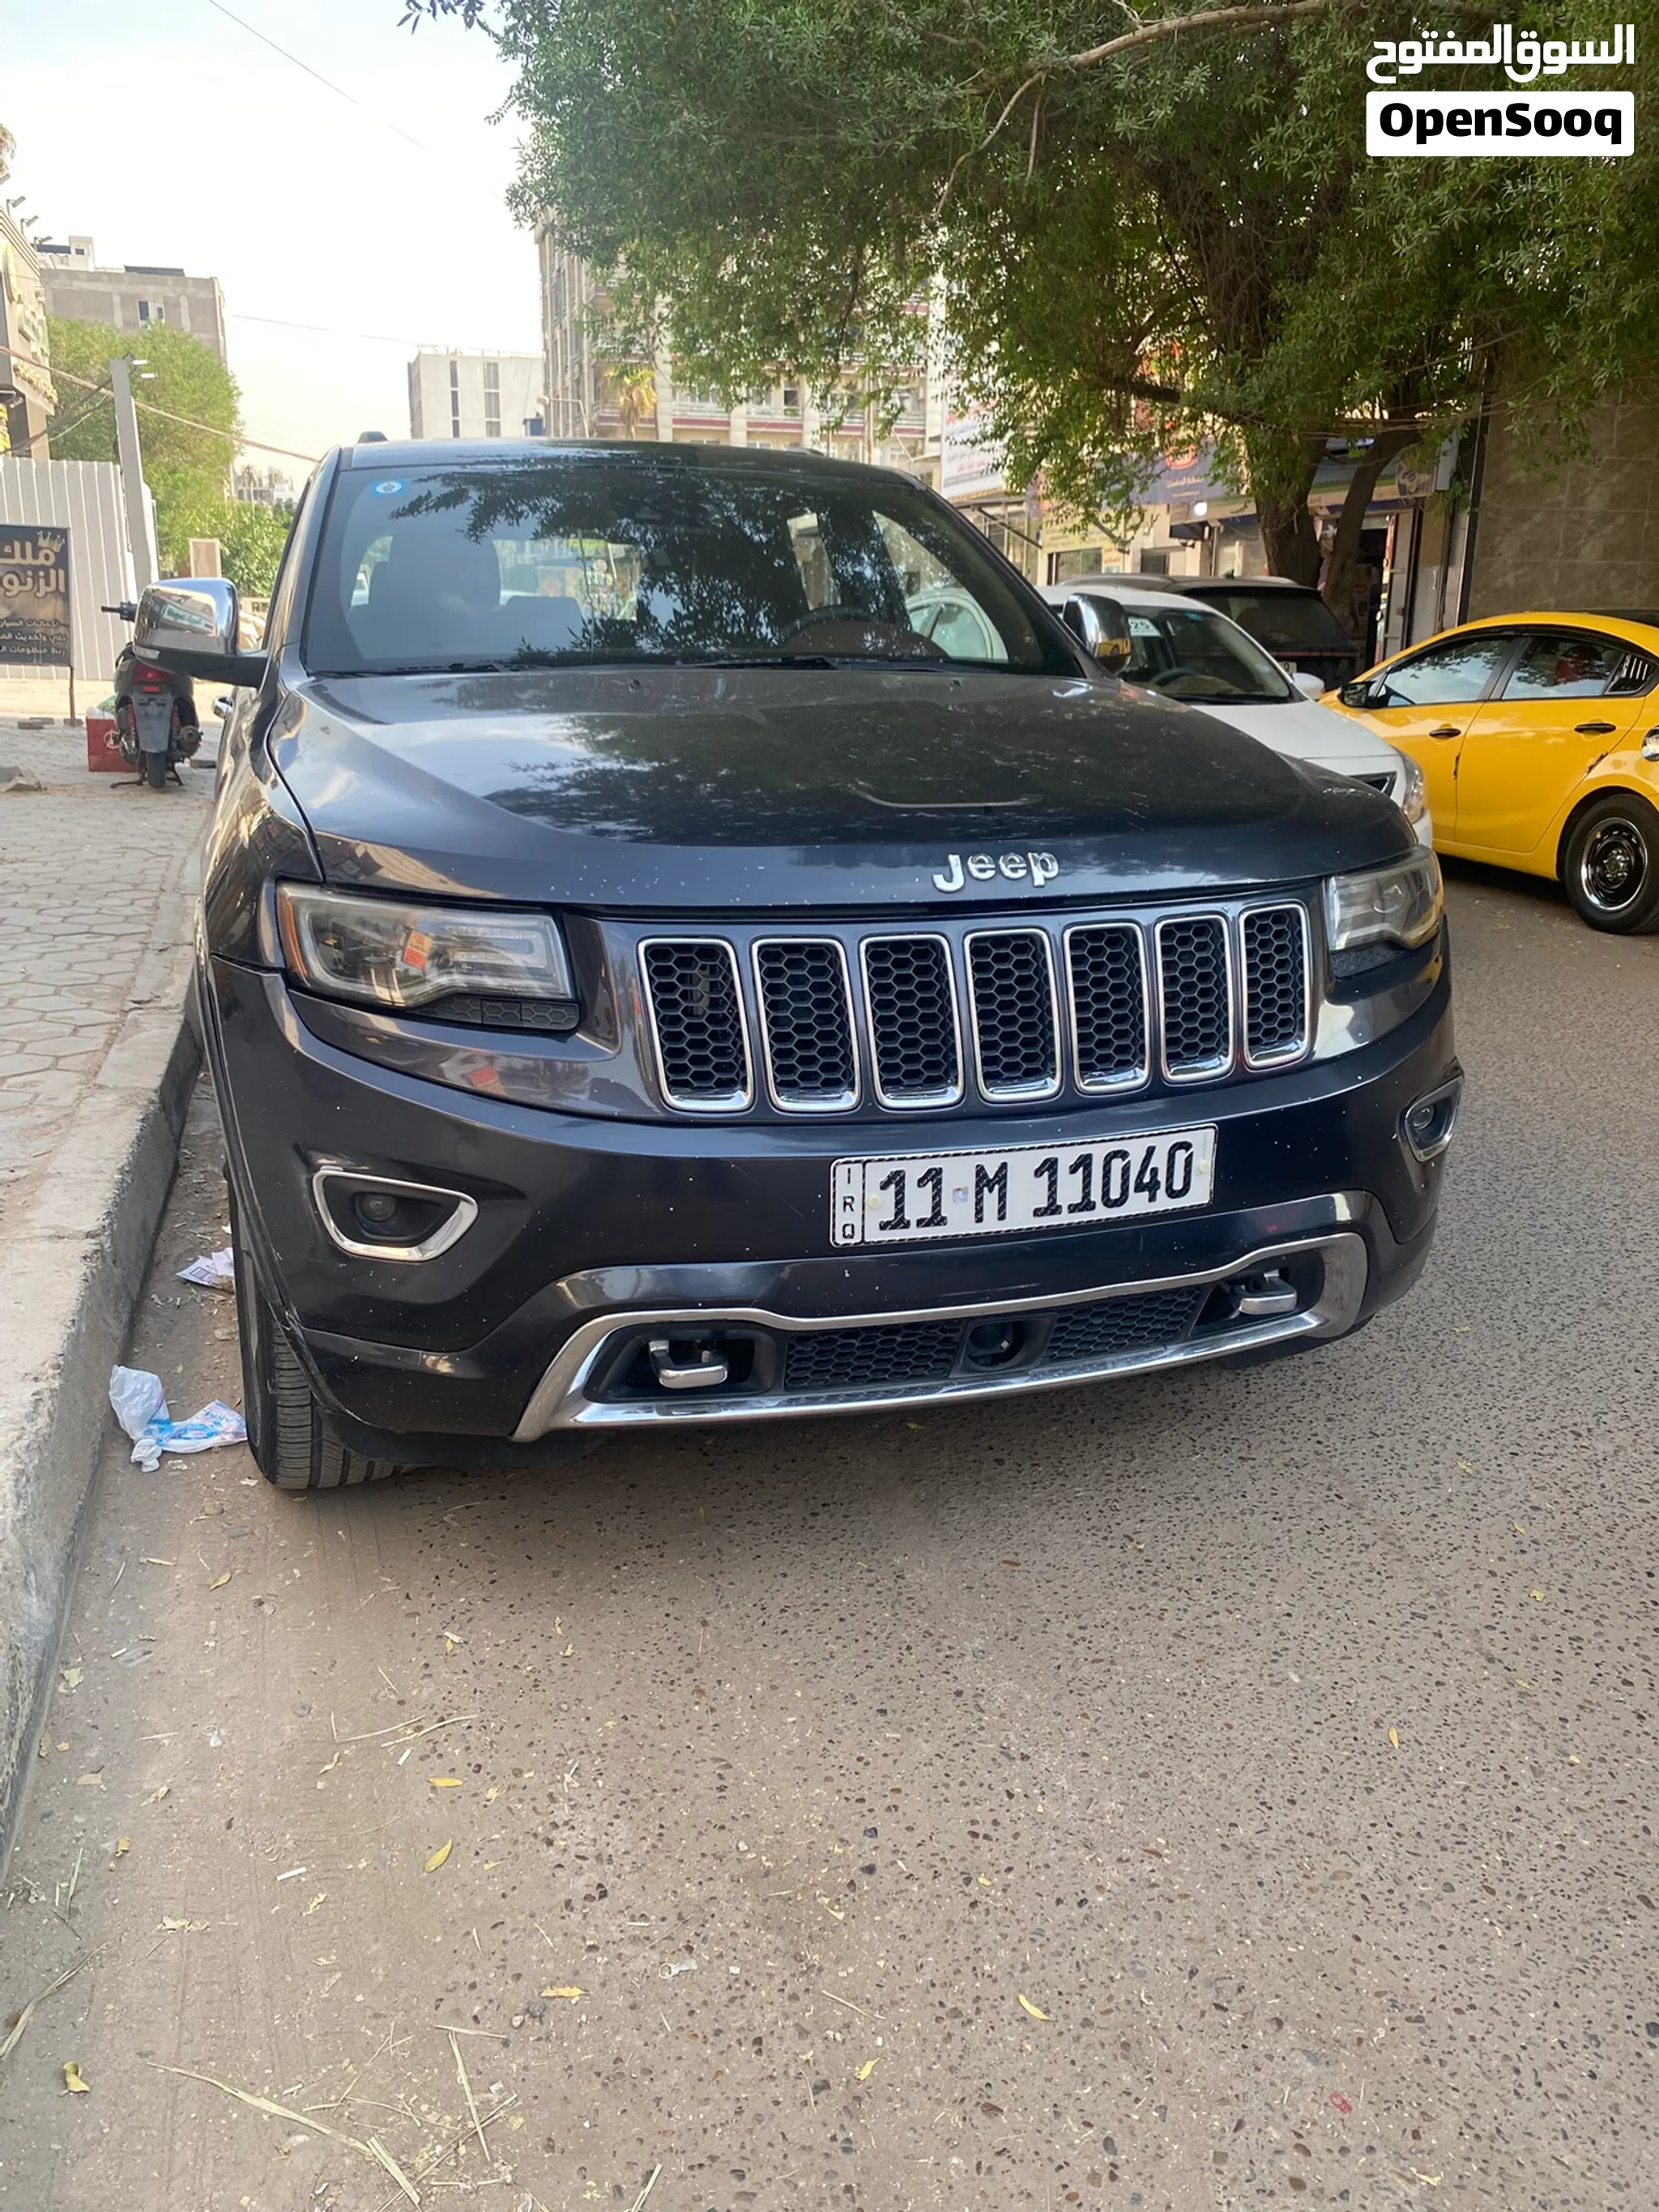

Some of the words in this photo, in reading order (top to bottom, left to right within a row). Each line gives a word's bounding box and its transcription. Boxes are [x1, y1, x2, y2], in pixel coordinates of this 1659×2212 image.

[932, 852, 1059, 892] Jeep
[879, 1166, 948, 1230] 11
[975, 1161, 1008, 1223] M
[1032, 1140, 1194, 1217] 11040
